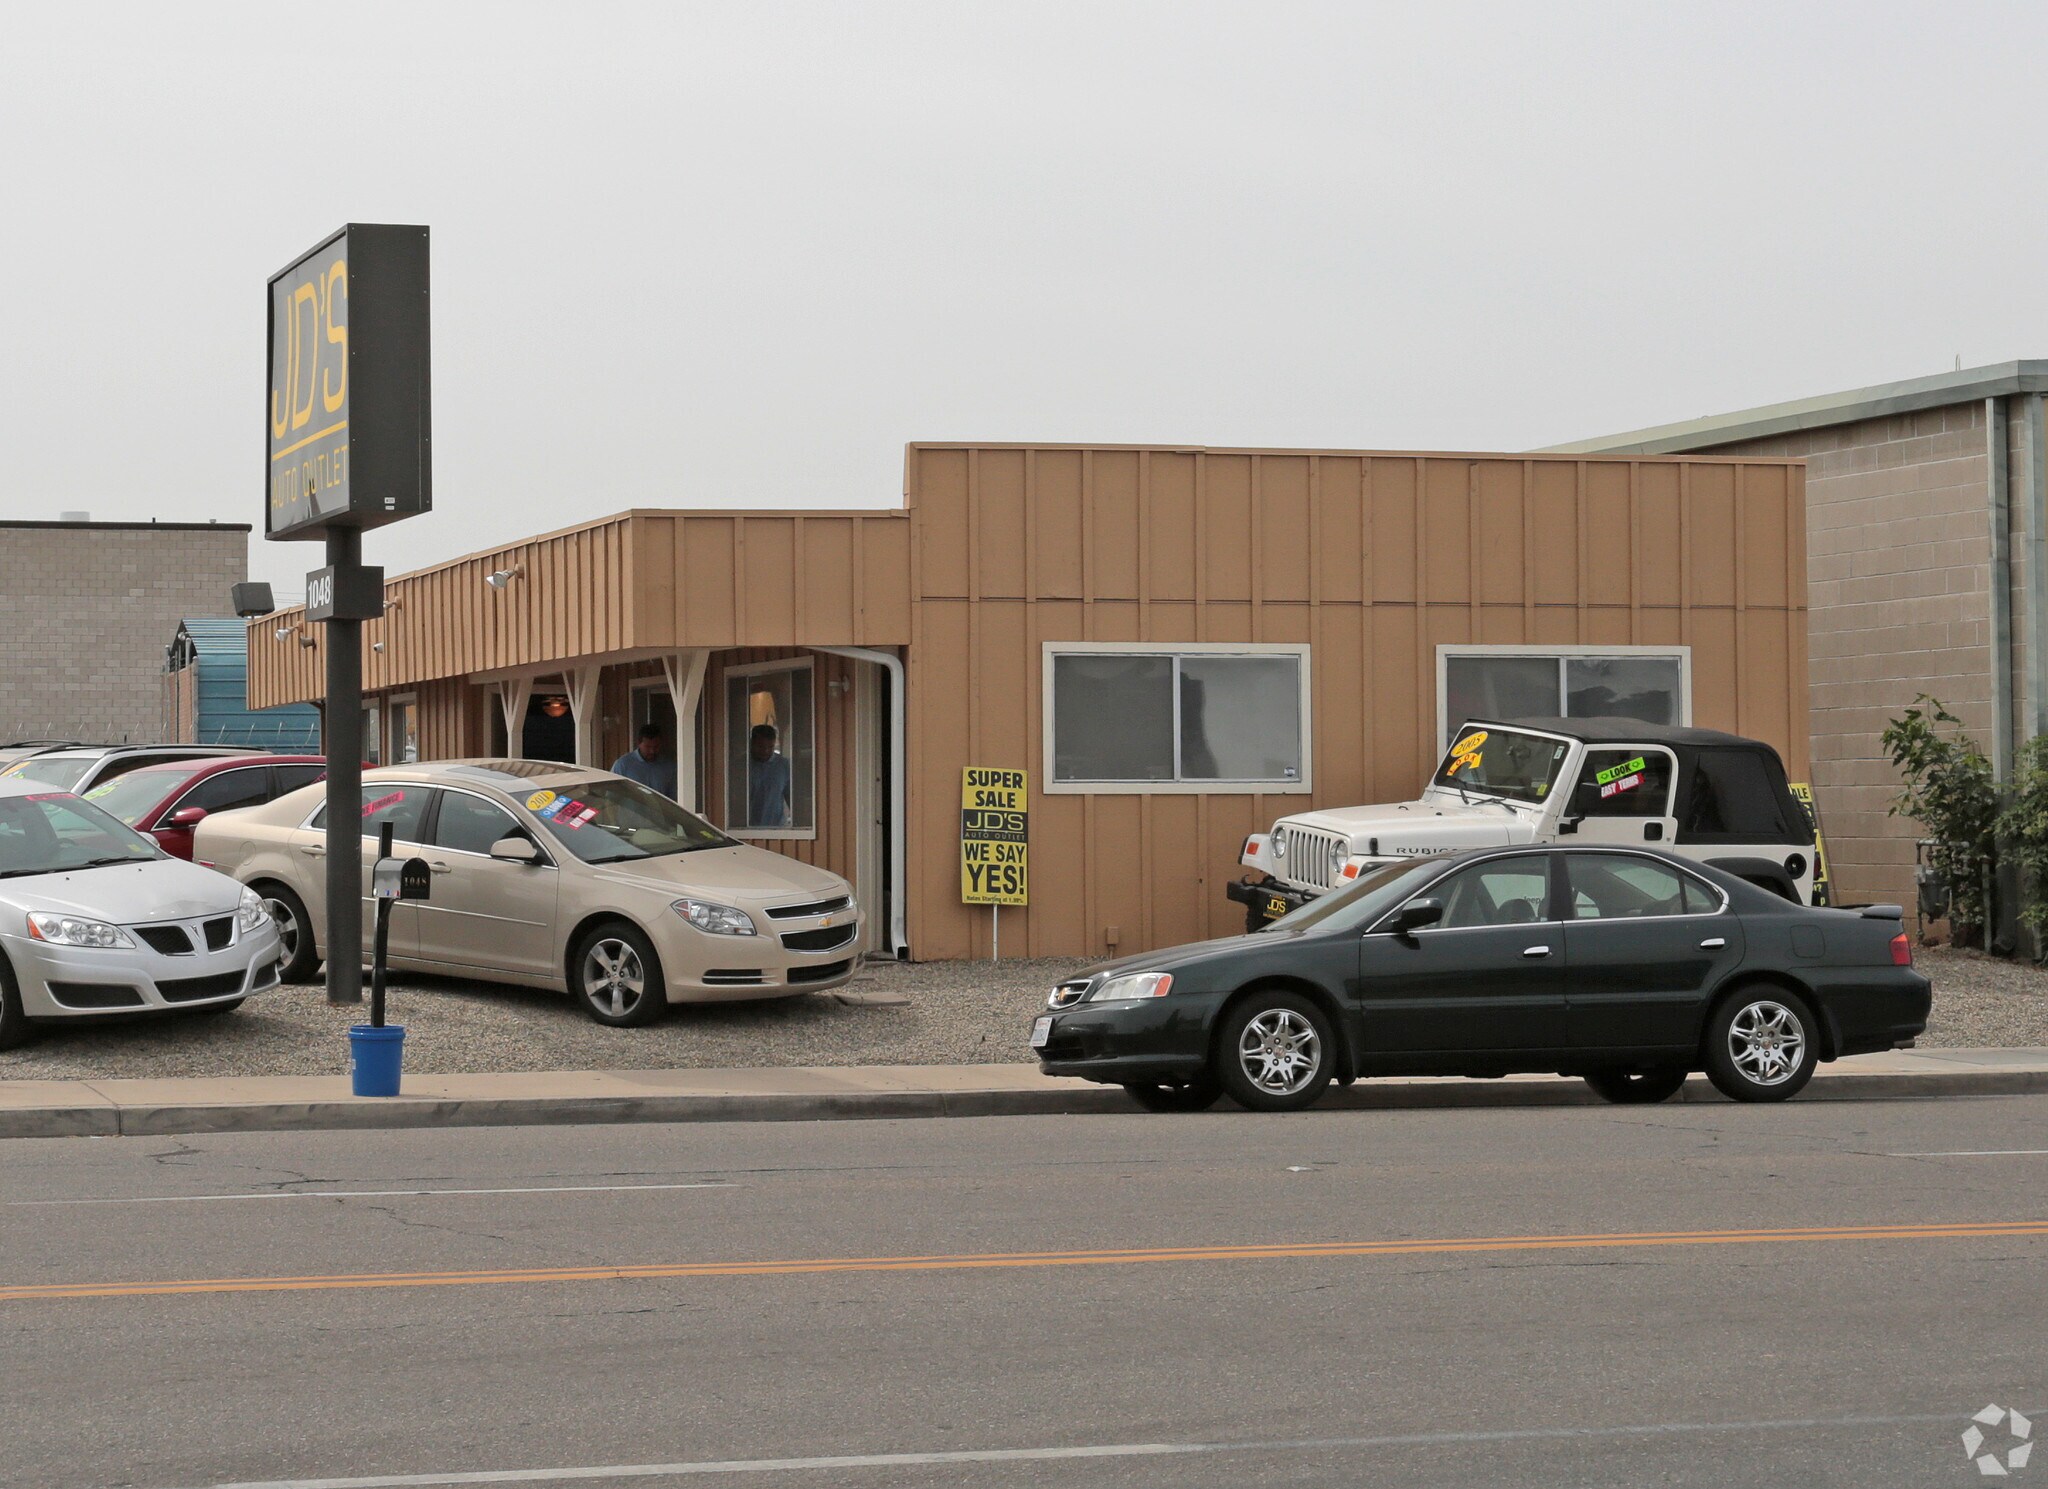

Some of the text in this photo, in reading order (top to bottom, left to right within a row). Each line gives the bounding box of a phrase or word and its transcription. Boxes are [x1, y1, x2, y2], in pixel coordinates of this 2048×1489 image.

[272, 259, 348, 439] JD'S
[272, 445, 348, 510] AUTO OUTLET
[308, 575, 331, 609] 1048
[967, 769, 1023, 789] SUPER
[1609, 763, 1632, 778] LOOK
[530, 792, 550, 808] 2011
[975, 790, 1016, 808] SALE
[966, 811, 1024, 831] JD'S
[994, 832, 1025, 841] OUTLET
[964, 842, 1025, 863] WE SAY
[404, 876, 427, 887] 1048
[966, 864, 1025, 895] YES!
